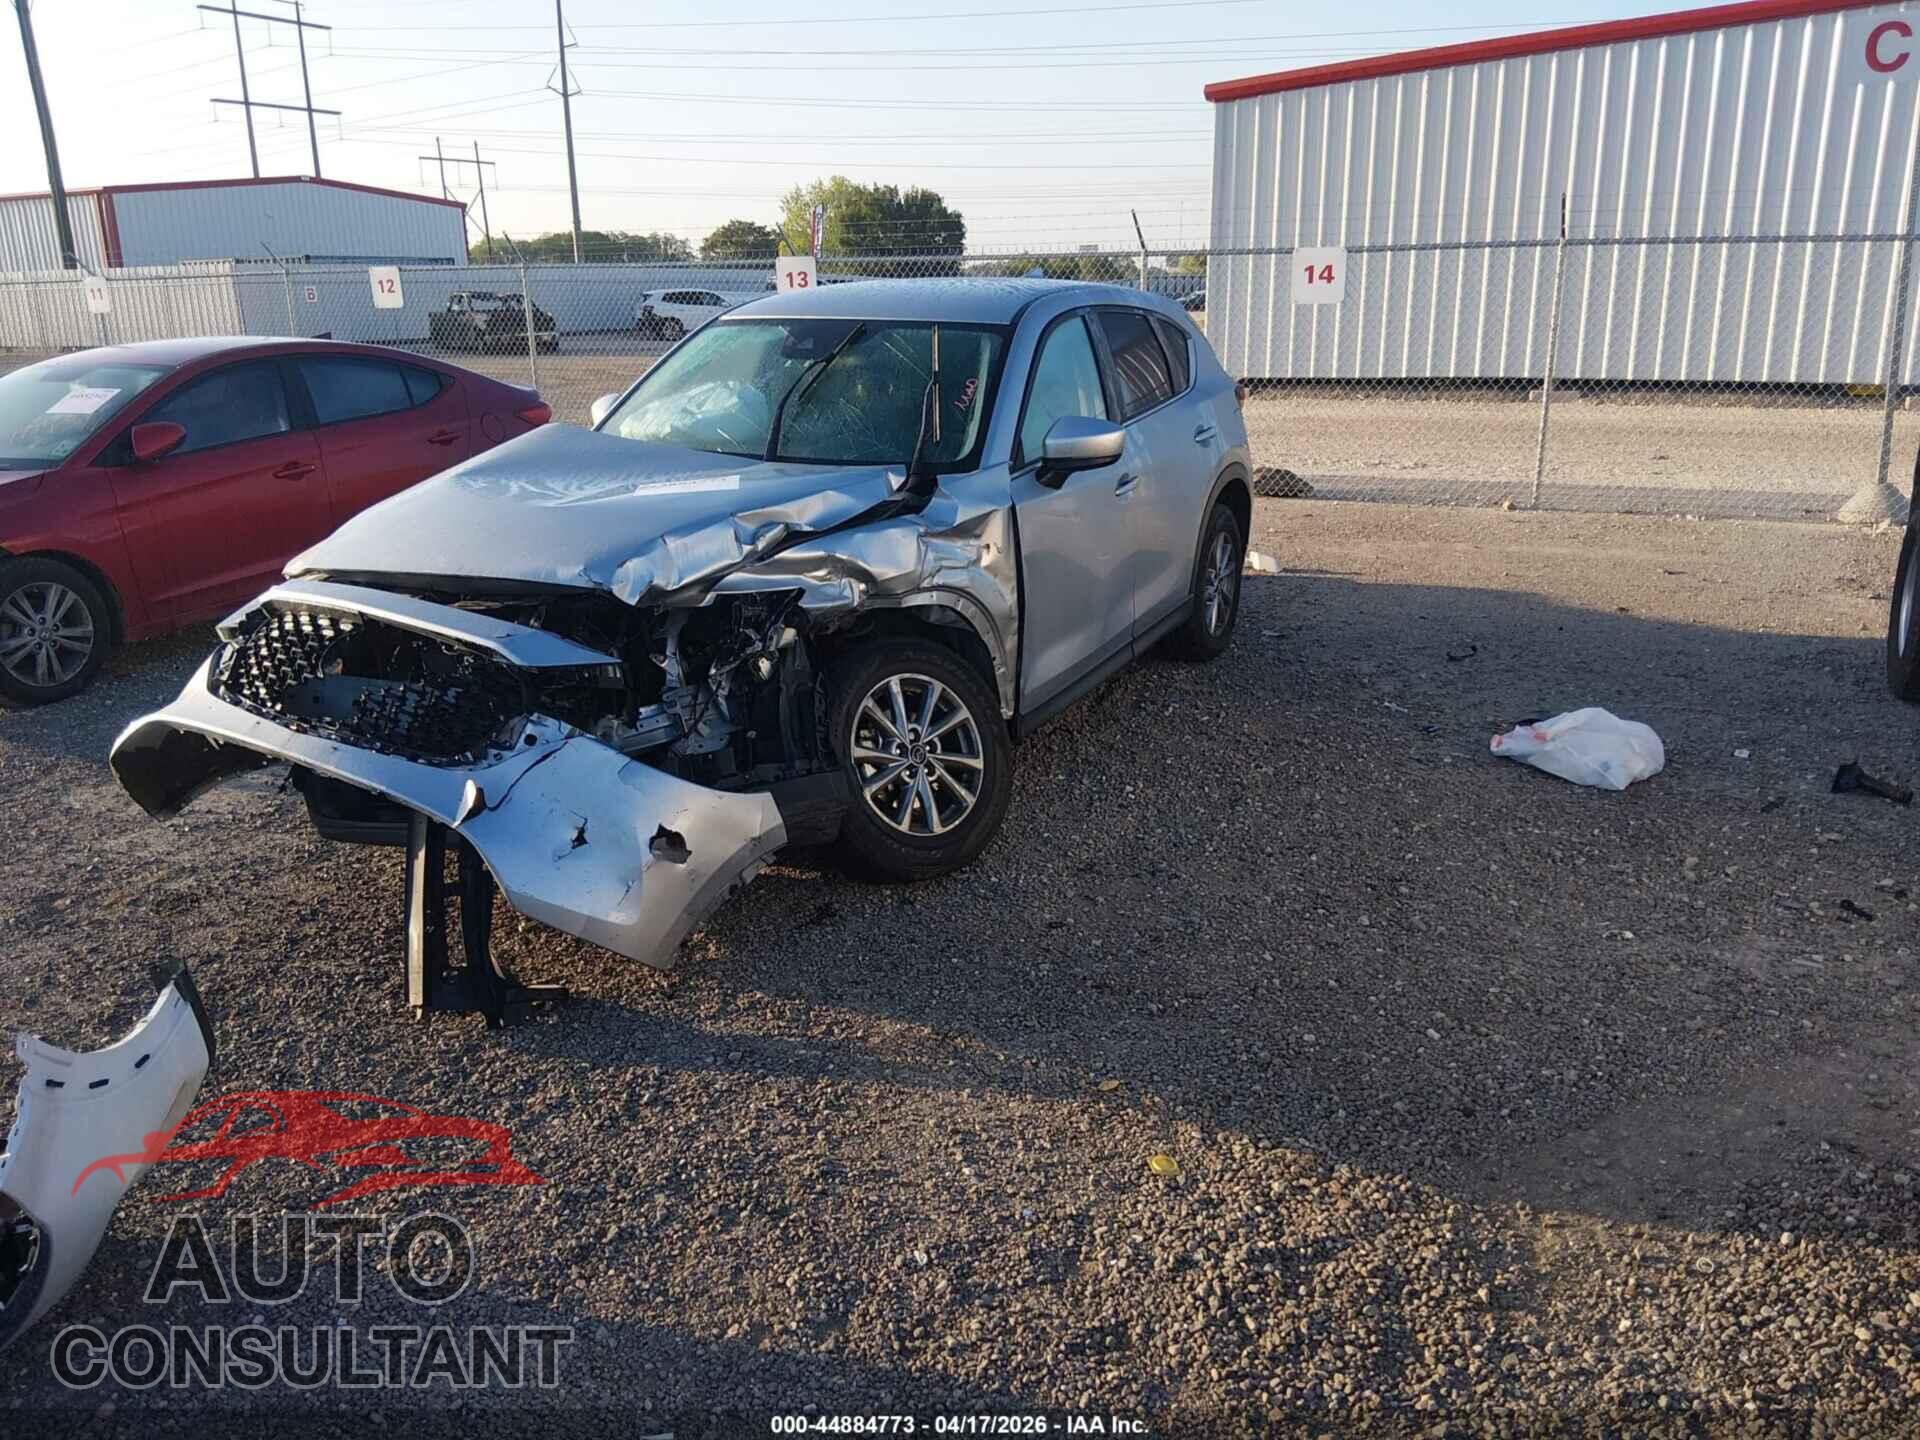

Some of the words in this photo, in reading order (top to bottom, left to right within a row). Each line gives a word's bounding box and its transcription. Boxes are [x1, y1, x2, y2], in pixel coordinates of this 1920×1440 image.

[1865, 20, 1912, 73] C
[785, 271, 809, 288] 13
[1303, 264, 1336, 284] 14
[90, 287, 104, 301] 11
[377, 279, 396, 294] 12
